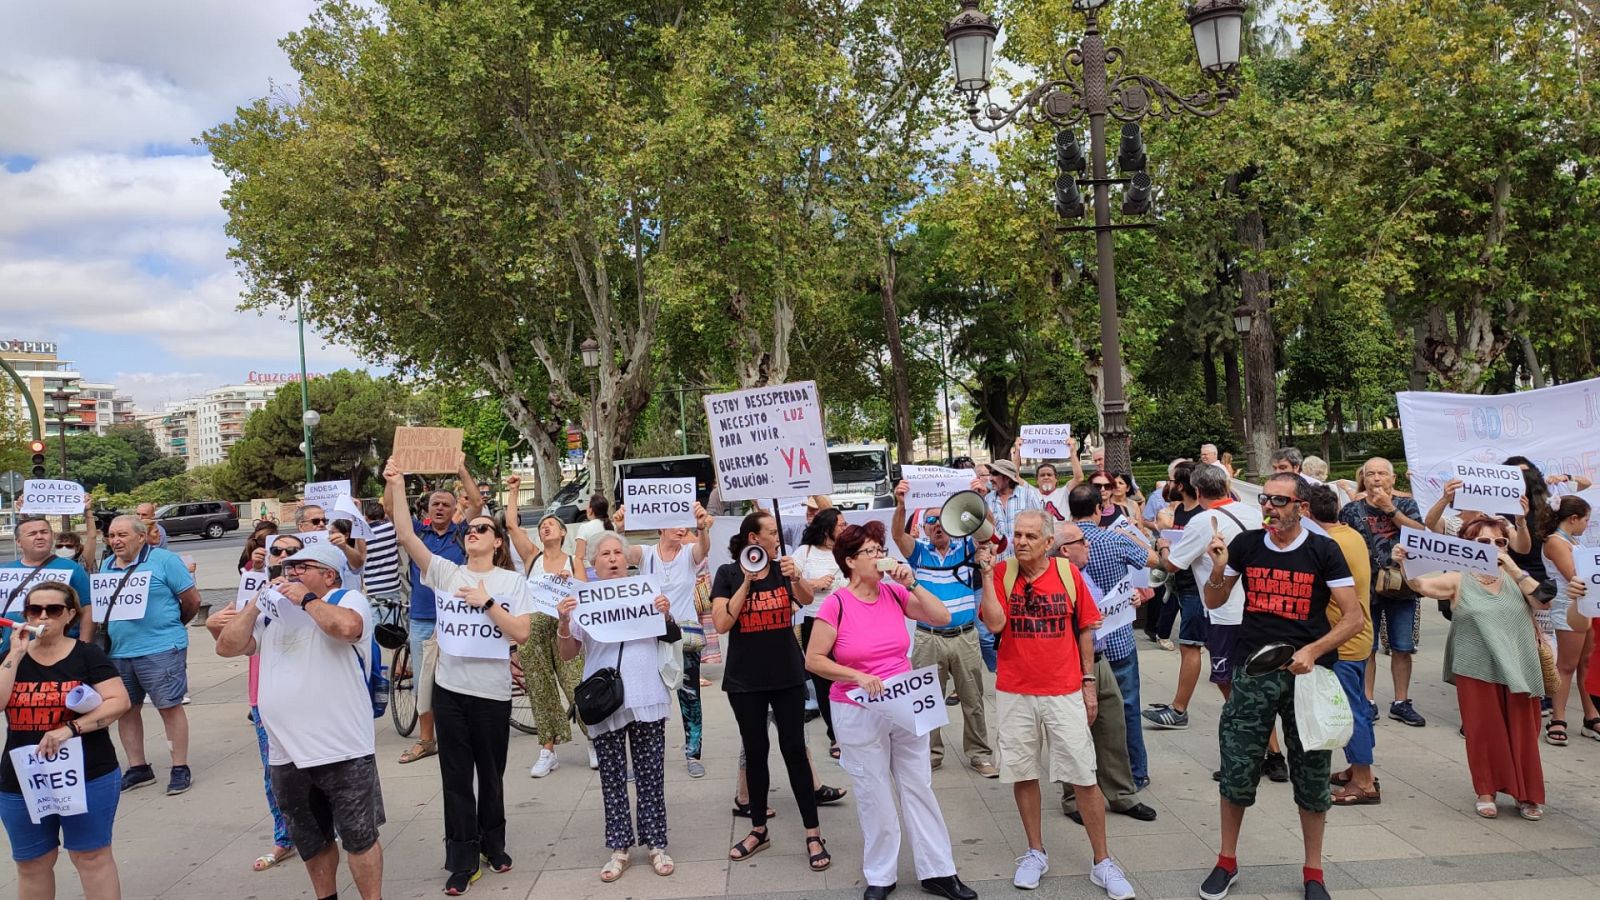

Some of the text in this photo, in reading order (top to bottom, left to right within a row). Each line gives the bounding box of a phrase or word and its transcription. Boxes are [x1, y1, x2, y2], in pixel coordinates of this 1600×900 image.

[719, 411, 767, 431] NECESITO
[1444, 402, 1534, 441] TODOS
[1023, 428, 1068, 436] #ENDESA
[719, 433, 743, 448] PARA
[718, 453, 769, 472] QUEREMOS
[1457, 465, 1520, 481] BARRIOS
[58, 483, 78, 491] LOS
[627, 483, 692, 496] BARRIOS
[1462, 483, 1520, 499] HARTOS
[26, 494, 81, 503] CORTES
[630, 501, 690, 514] HARTOS
[1406, 534, 1489, 562] ENDESA
[1246, 567, 1270, 578] SOY
[1272, 569, 1290, 581] DE
[578, 581, 653, 604] ENDESA
[578, 603, 660, 626] CRIMINAL
[1010, 618, 1066, 633] HARTO
